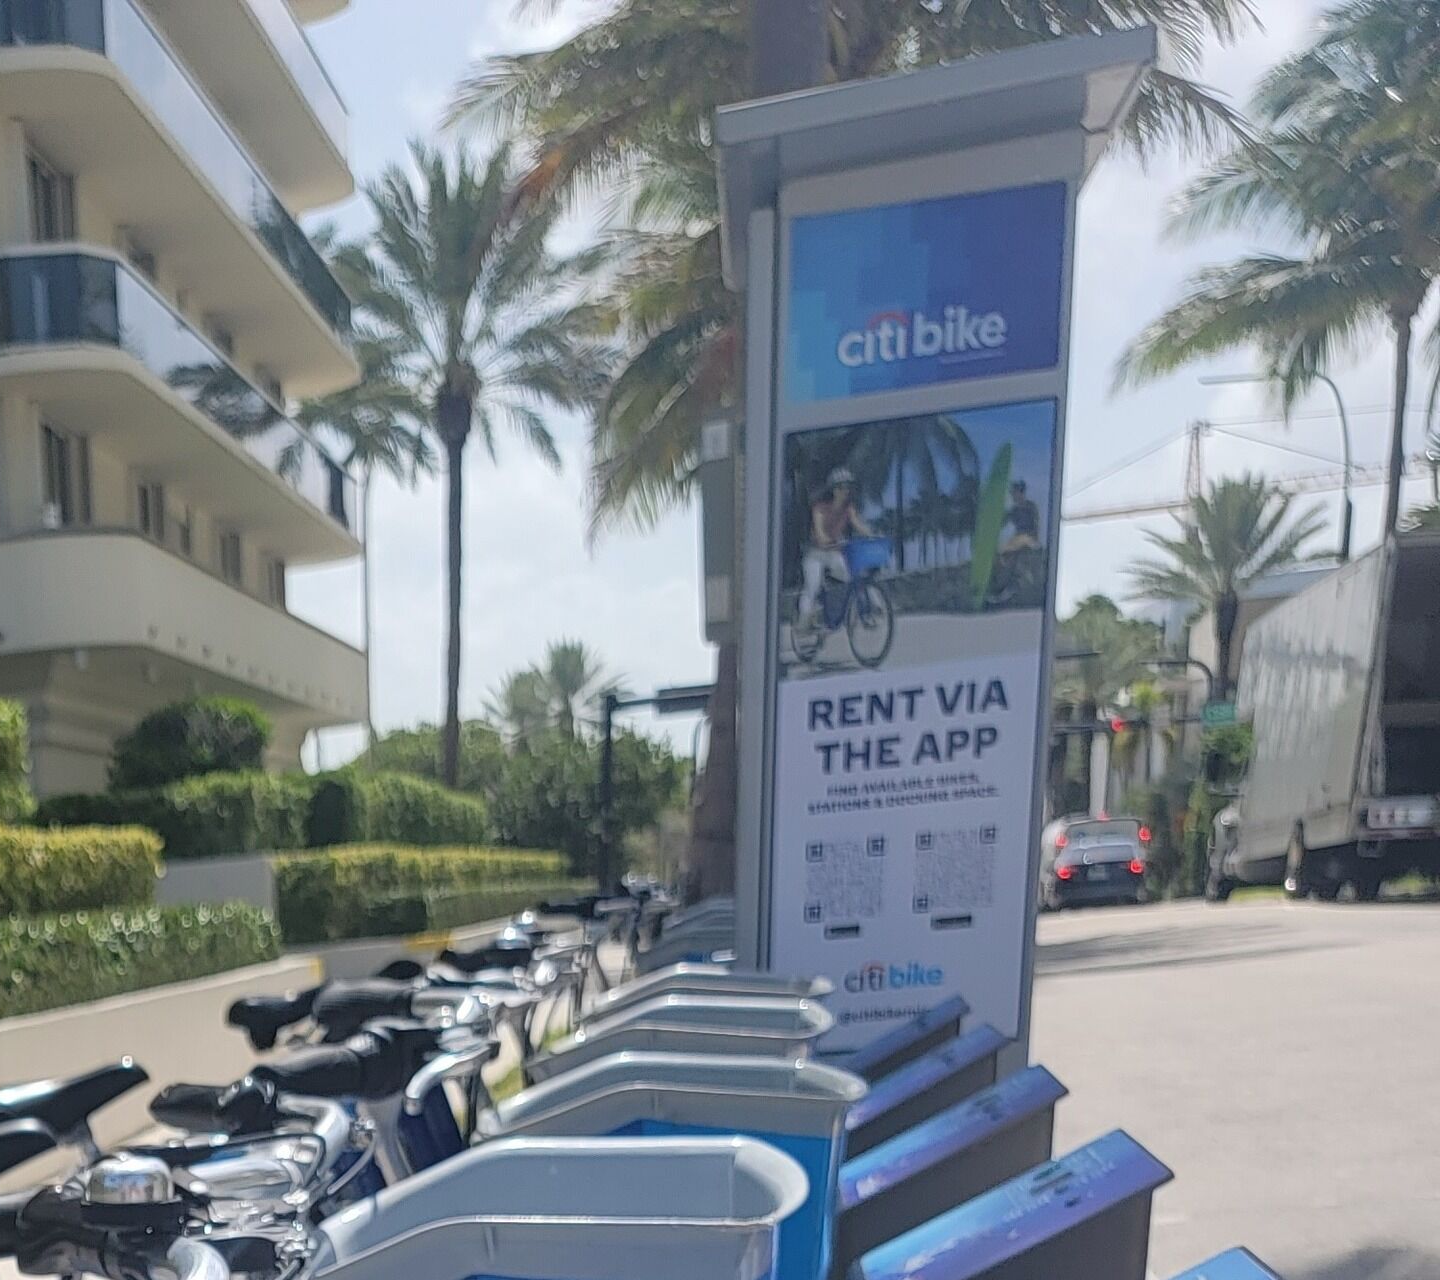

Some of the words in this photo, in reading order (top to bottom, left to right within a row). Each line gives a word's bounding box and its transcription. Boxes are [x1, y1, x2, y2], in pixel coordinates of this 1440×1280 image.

[807, 687, 925, 732] RENT
[935, 677, 1009, 716] VIA
[814, 736, 901, 775] THE
[912, 726, 998, 766] APP
